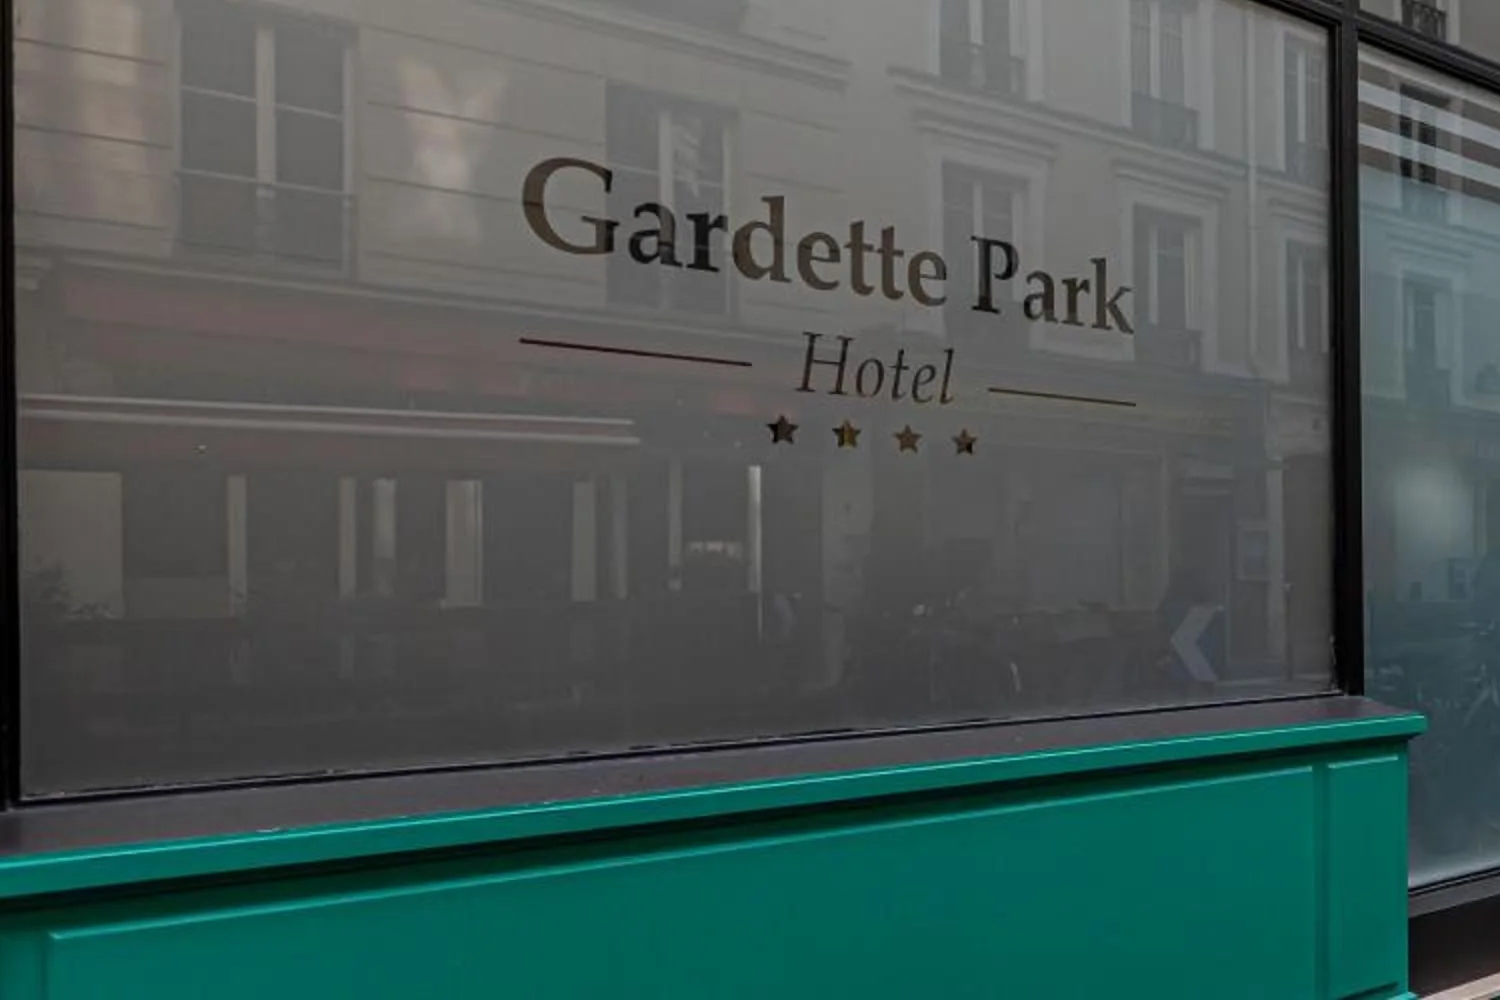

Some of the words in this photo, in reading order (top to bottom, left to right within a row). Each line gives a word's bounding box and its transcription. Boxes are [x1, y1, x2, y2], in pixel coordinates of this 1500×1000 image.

[521, 156, 948, 307] Gardette
[969, 234, 1136, 336] Park
[795, 331, 956, 405] Hotel
